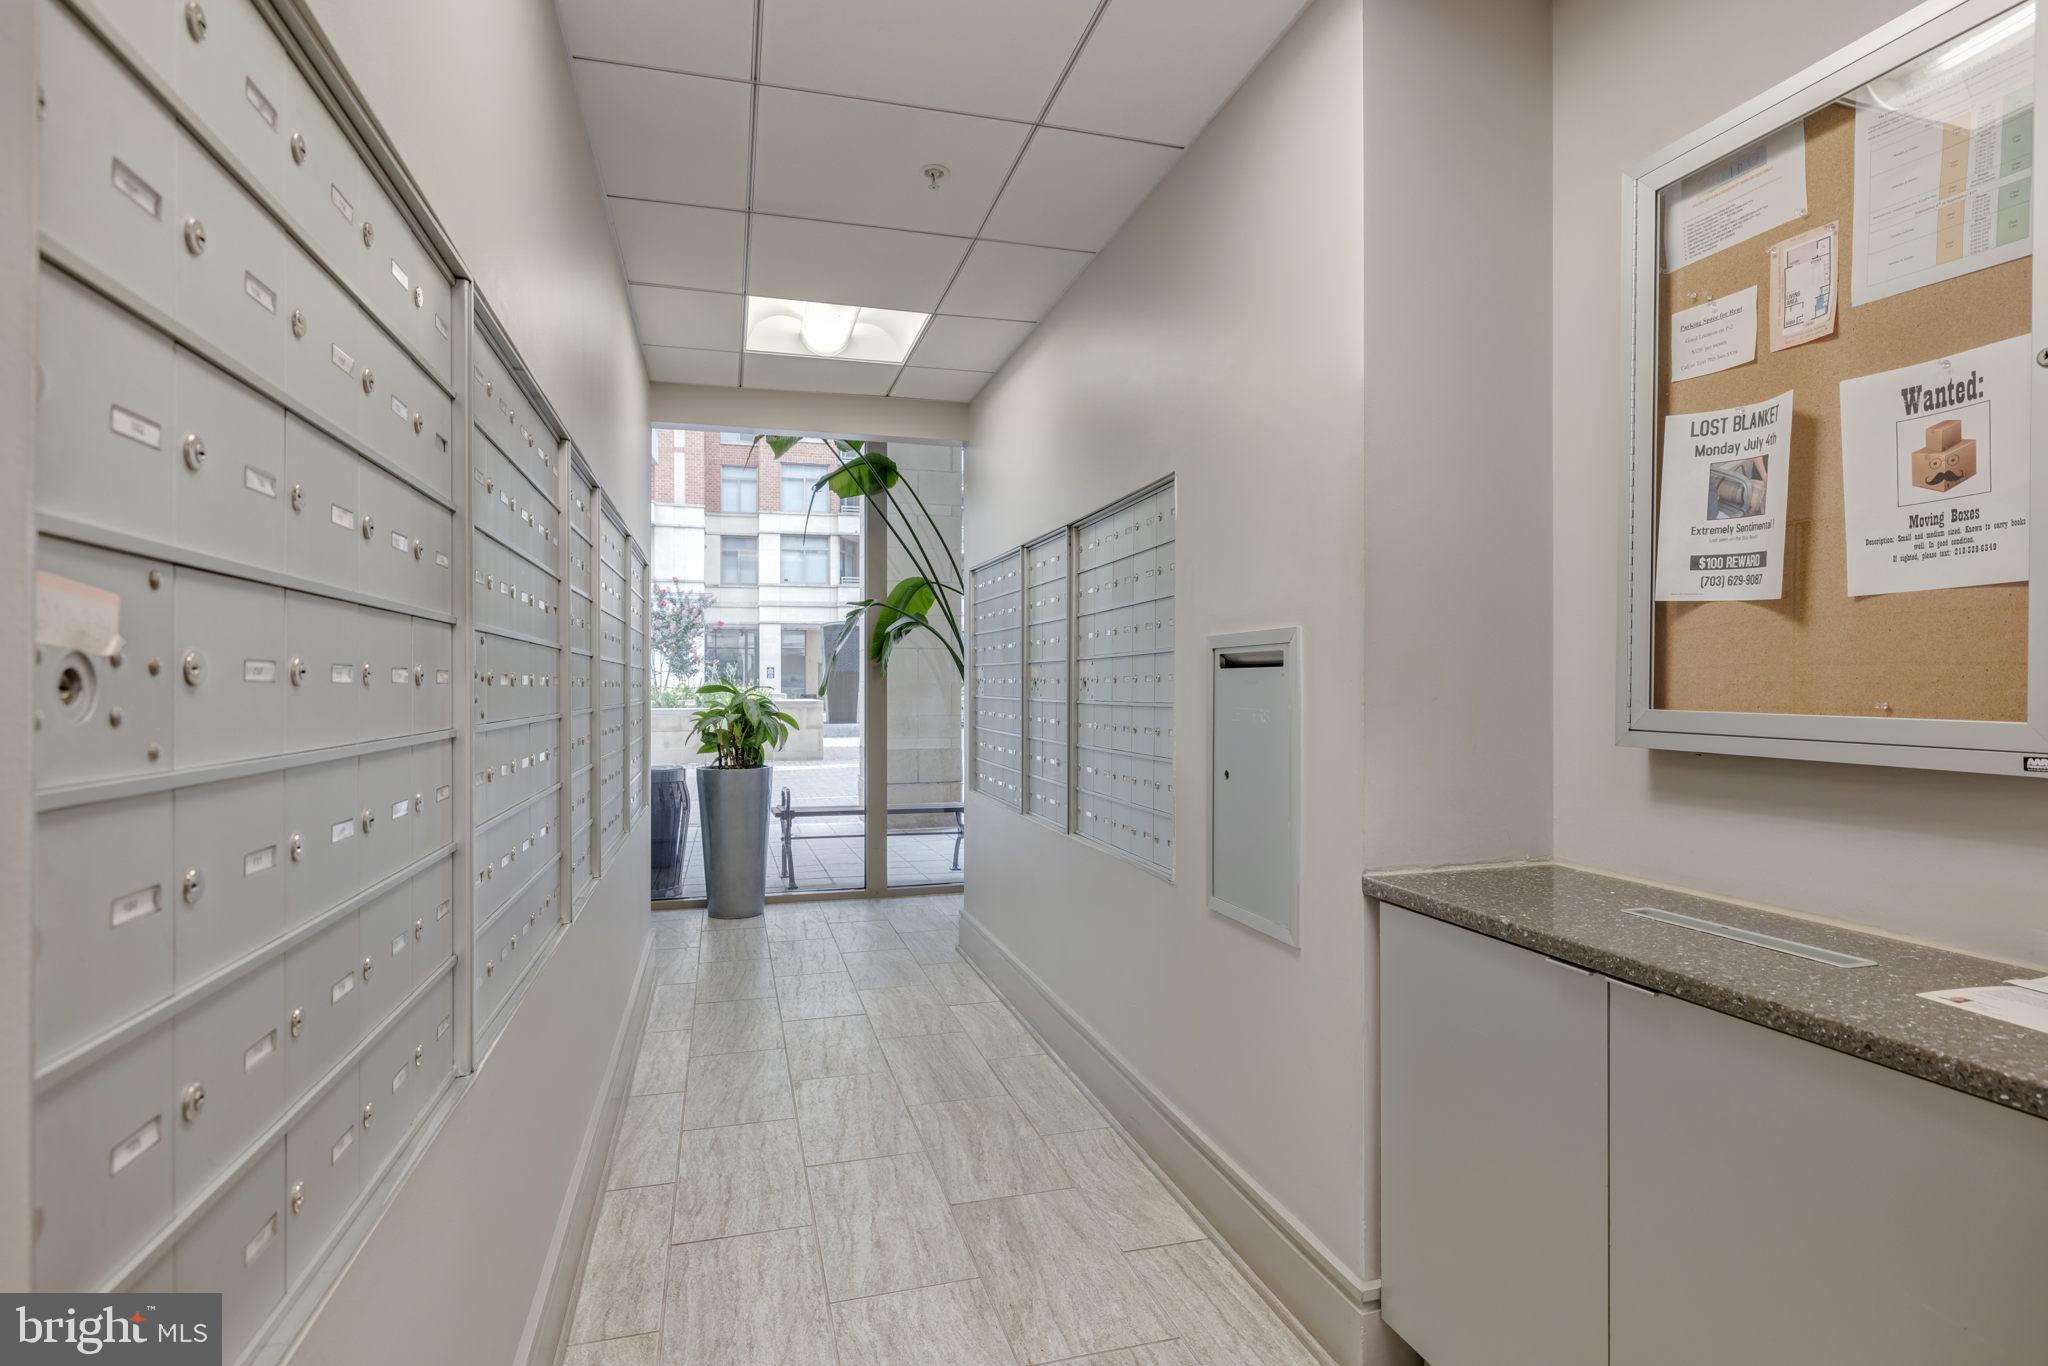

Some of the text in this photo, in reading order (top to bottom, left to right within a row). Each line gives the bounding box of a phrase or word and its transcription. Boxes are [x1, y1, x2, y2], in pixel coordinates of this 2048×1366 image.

[1680, 306, 1743, 332] Parking Space for Rent
[1901, 370, 1984, 416] Wanted:
[1690, 404, 1780, 438] LOST BLANKET
[1695, 432, 1777, 458] Monday July 4th
[1691, 518, 1775, 536] Extremely Sentimental!
[1909, 508, 1980, 529] Moving Boxes
[1866, 536, 1895, 546] Description:
[1898, 534, 1911, 542] Small
[1915, 532, 1923, 540] and
[1926, 530, 1945, 539] medium
[1948, 528, 1961, 536] sized.
[1965, 525, 1982, 534] Known
[1994, 521, 2008, 530] carry
[2011, 518, 2026, 527] books
[1937, 539, 1948, 549] good
[1951, 536, 1974, 546] condition.
[1699, 554, 1760, 569] $100 REWARD
[1892, 555, 1897, 563] If
[1900, 553, 1919, 563] sighted,
[1922, 551, 1937, 561] please
[1940, 550, 1951, 558] text:
[1700, 574, 1763, 588] (703) 629-9087
